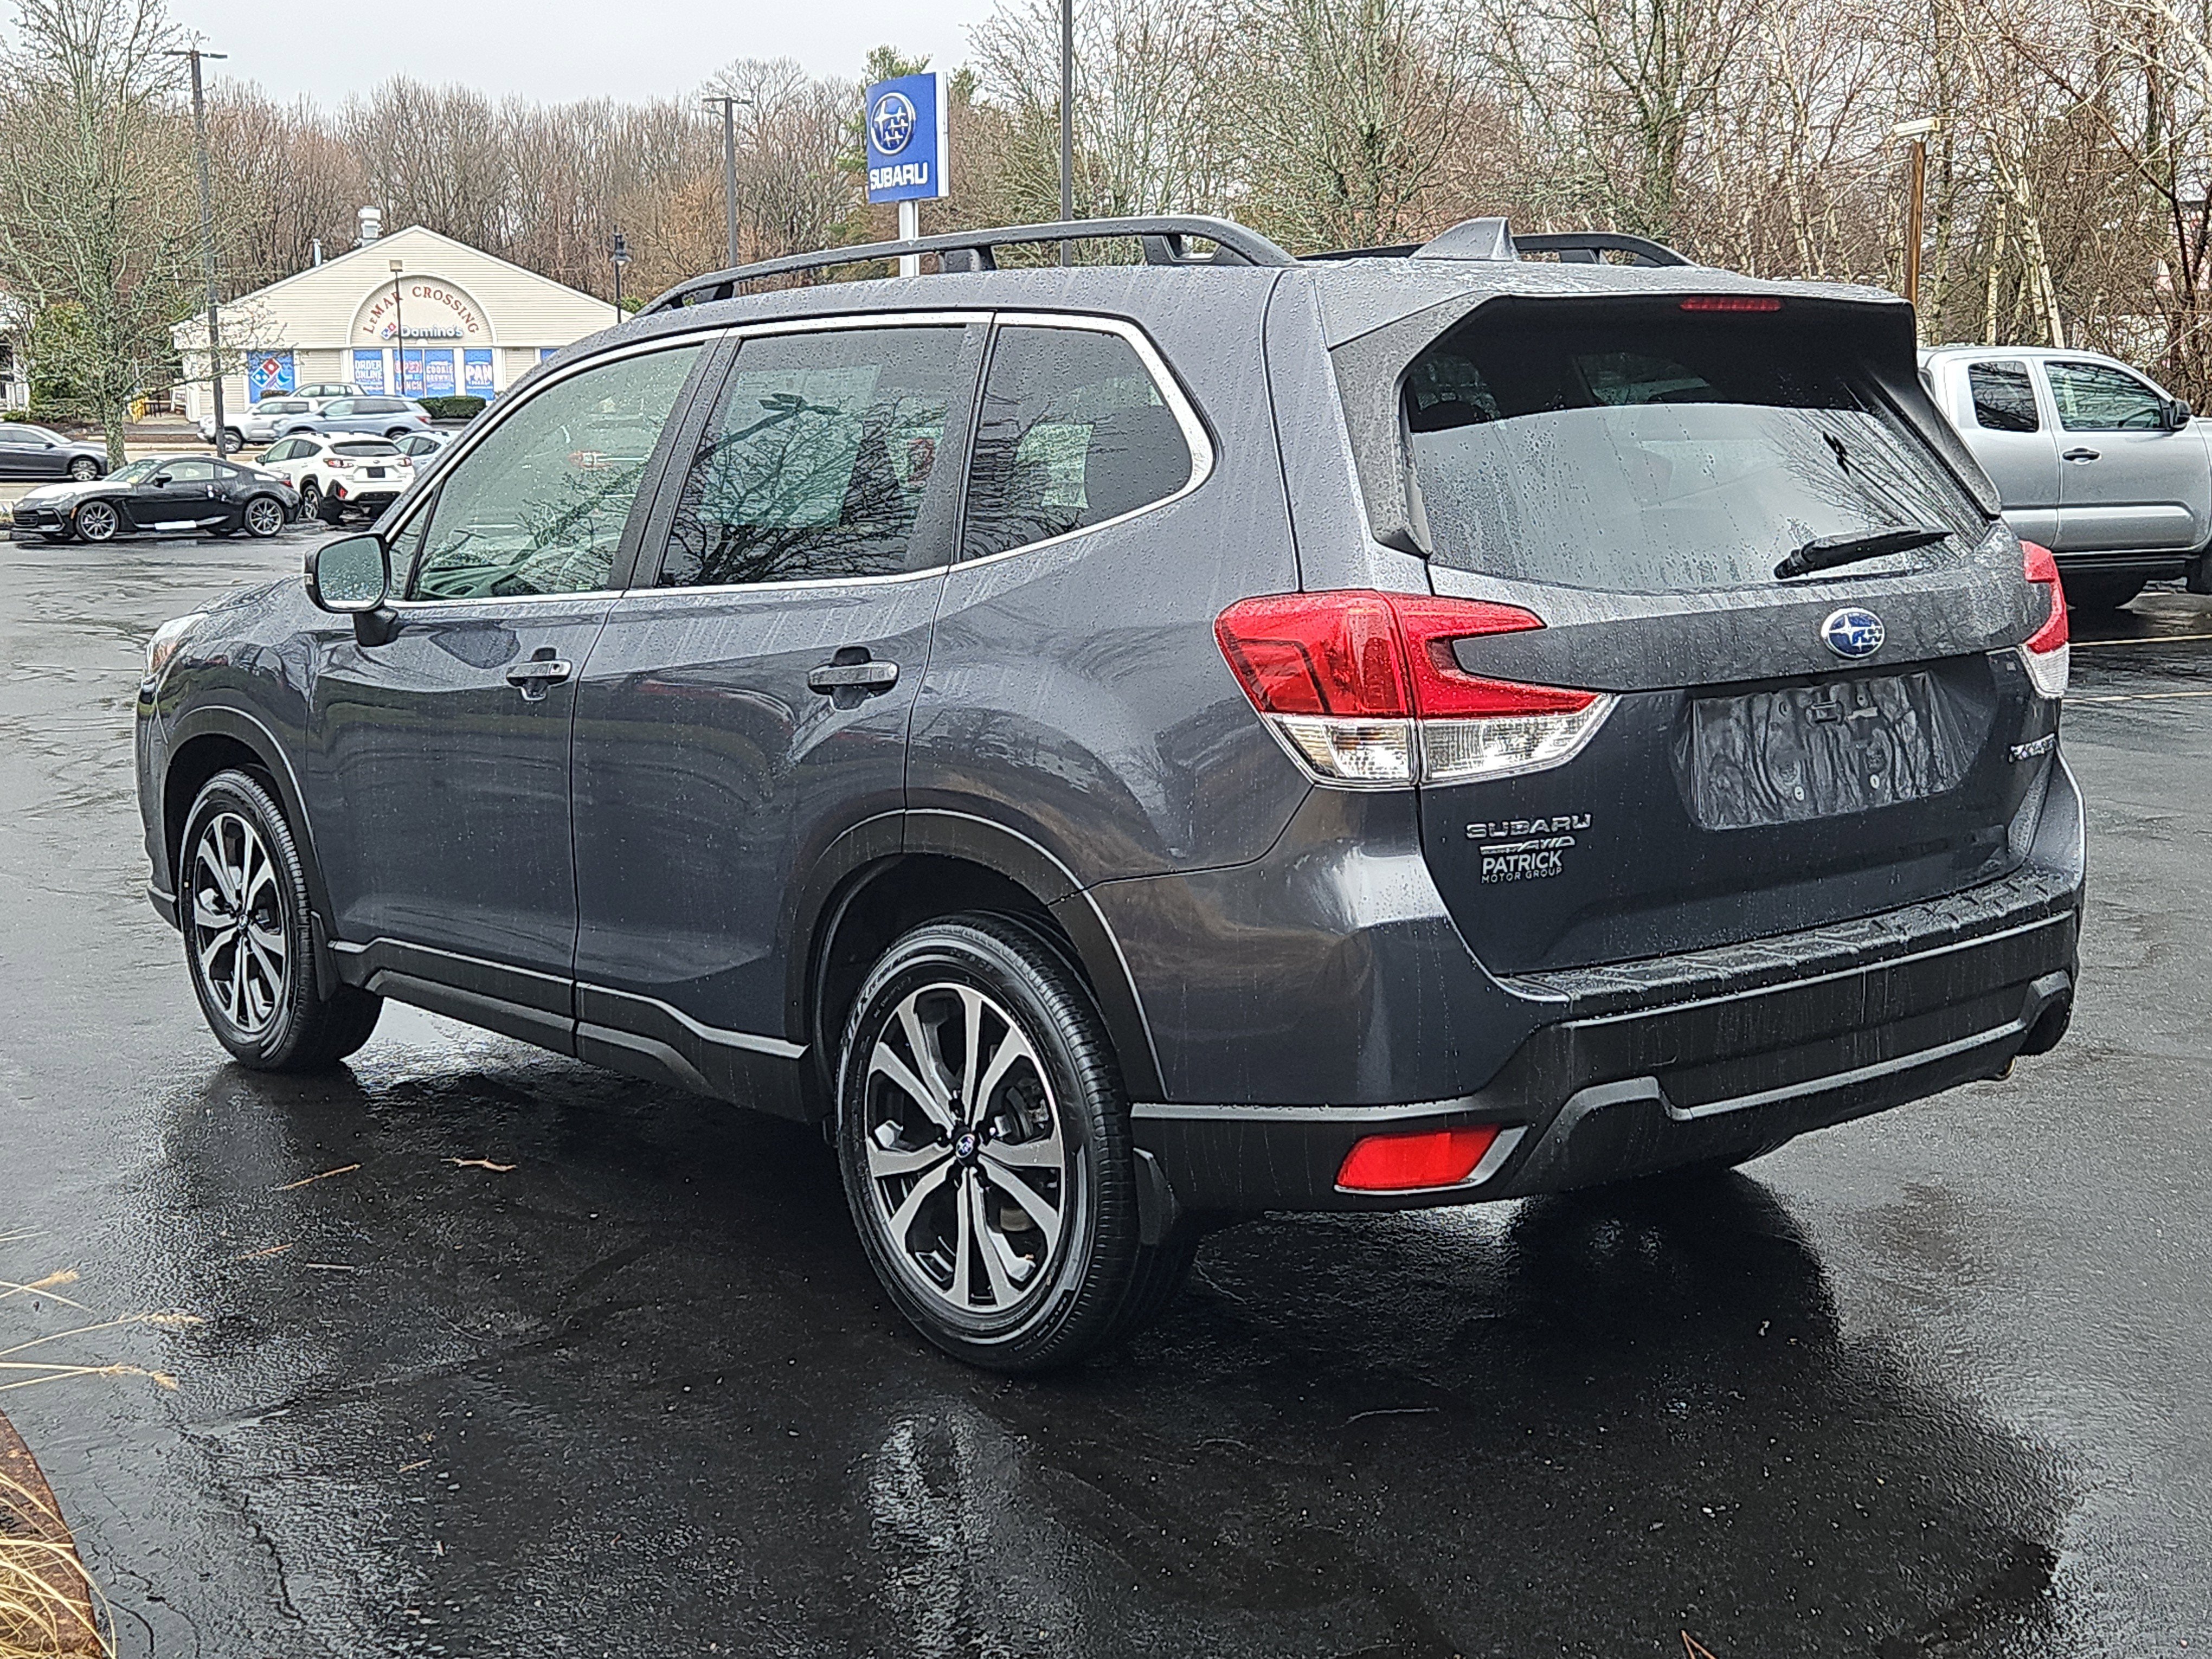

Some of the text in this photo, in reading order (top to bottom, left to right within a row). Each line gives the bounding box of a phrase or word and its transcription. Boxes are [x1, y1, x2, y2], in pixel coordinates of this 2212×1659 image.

[870, 162, 928, 190] SUBARU
[412, 286, 479, 333] CROSSING
[401, 324, 464, 337] Domino's
[355, 360, 382, 370] ORDER
[465, 365, 492, 382] PAN
[355, 370, 383, 380] ONLINE
[396, 380, 422, 390] LNCH
[1466, 814, 1592, 839] SUBARU
[1482, 850, 1563, 875] PATRICK
[1481, 867, 1562, 884] MOTOR GROUP
